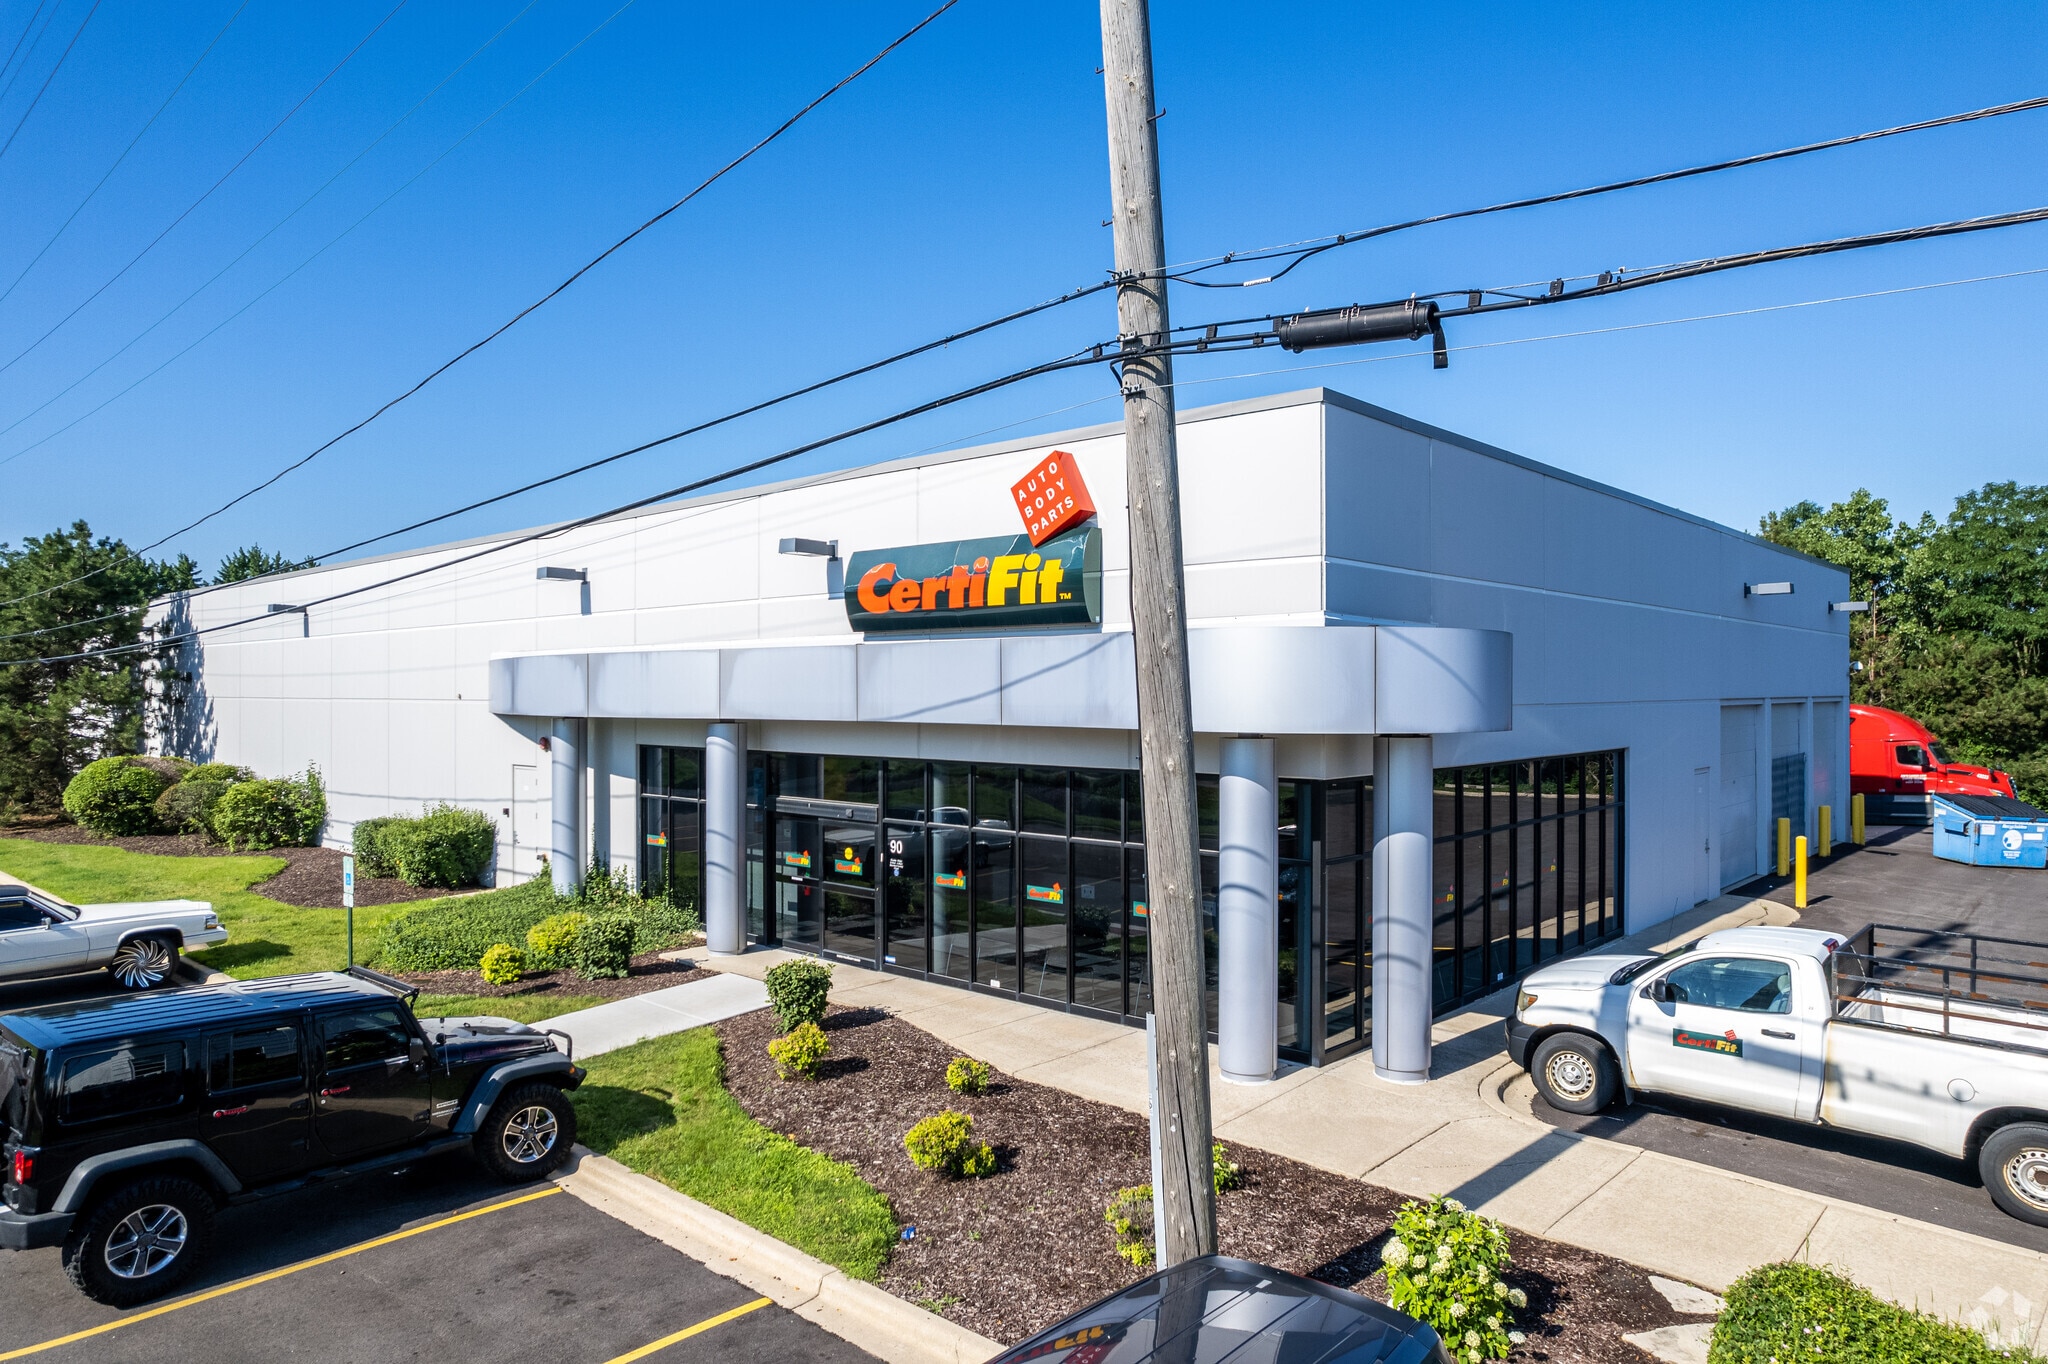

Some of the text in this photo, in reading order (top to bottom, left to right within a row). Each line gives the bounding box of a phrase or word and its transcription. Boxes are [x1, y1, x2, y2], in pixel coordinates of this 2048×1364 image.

[1018, 462, 1057, 502] AUTO
[1024, 478, 1064, 518] BODY
[1031, 496, 1073, 536] PARTS
[857, 553, 1064, 614] CertiFit
[890, 840, 903, 854] 90
[1677, 1033, 1738, 1053] CertiFit
